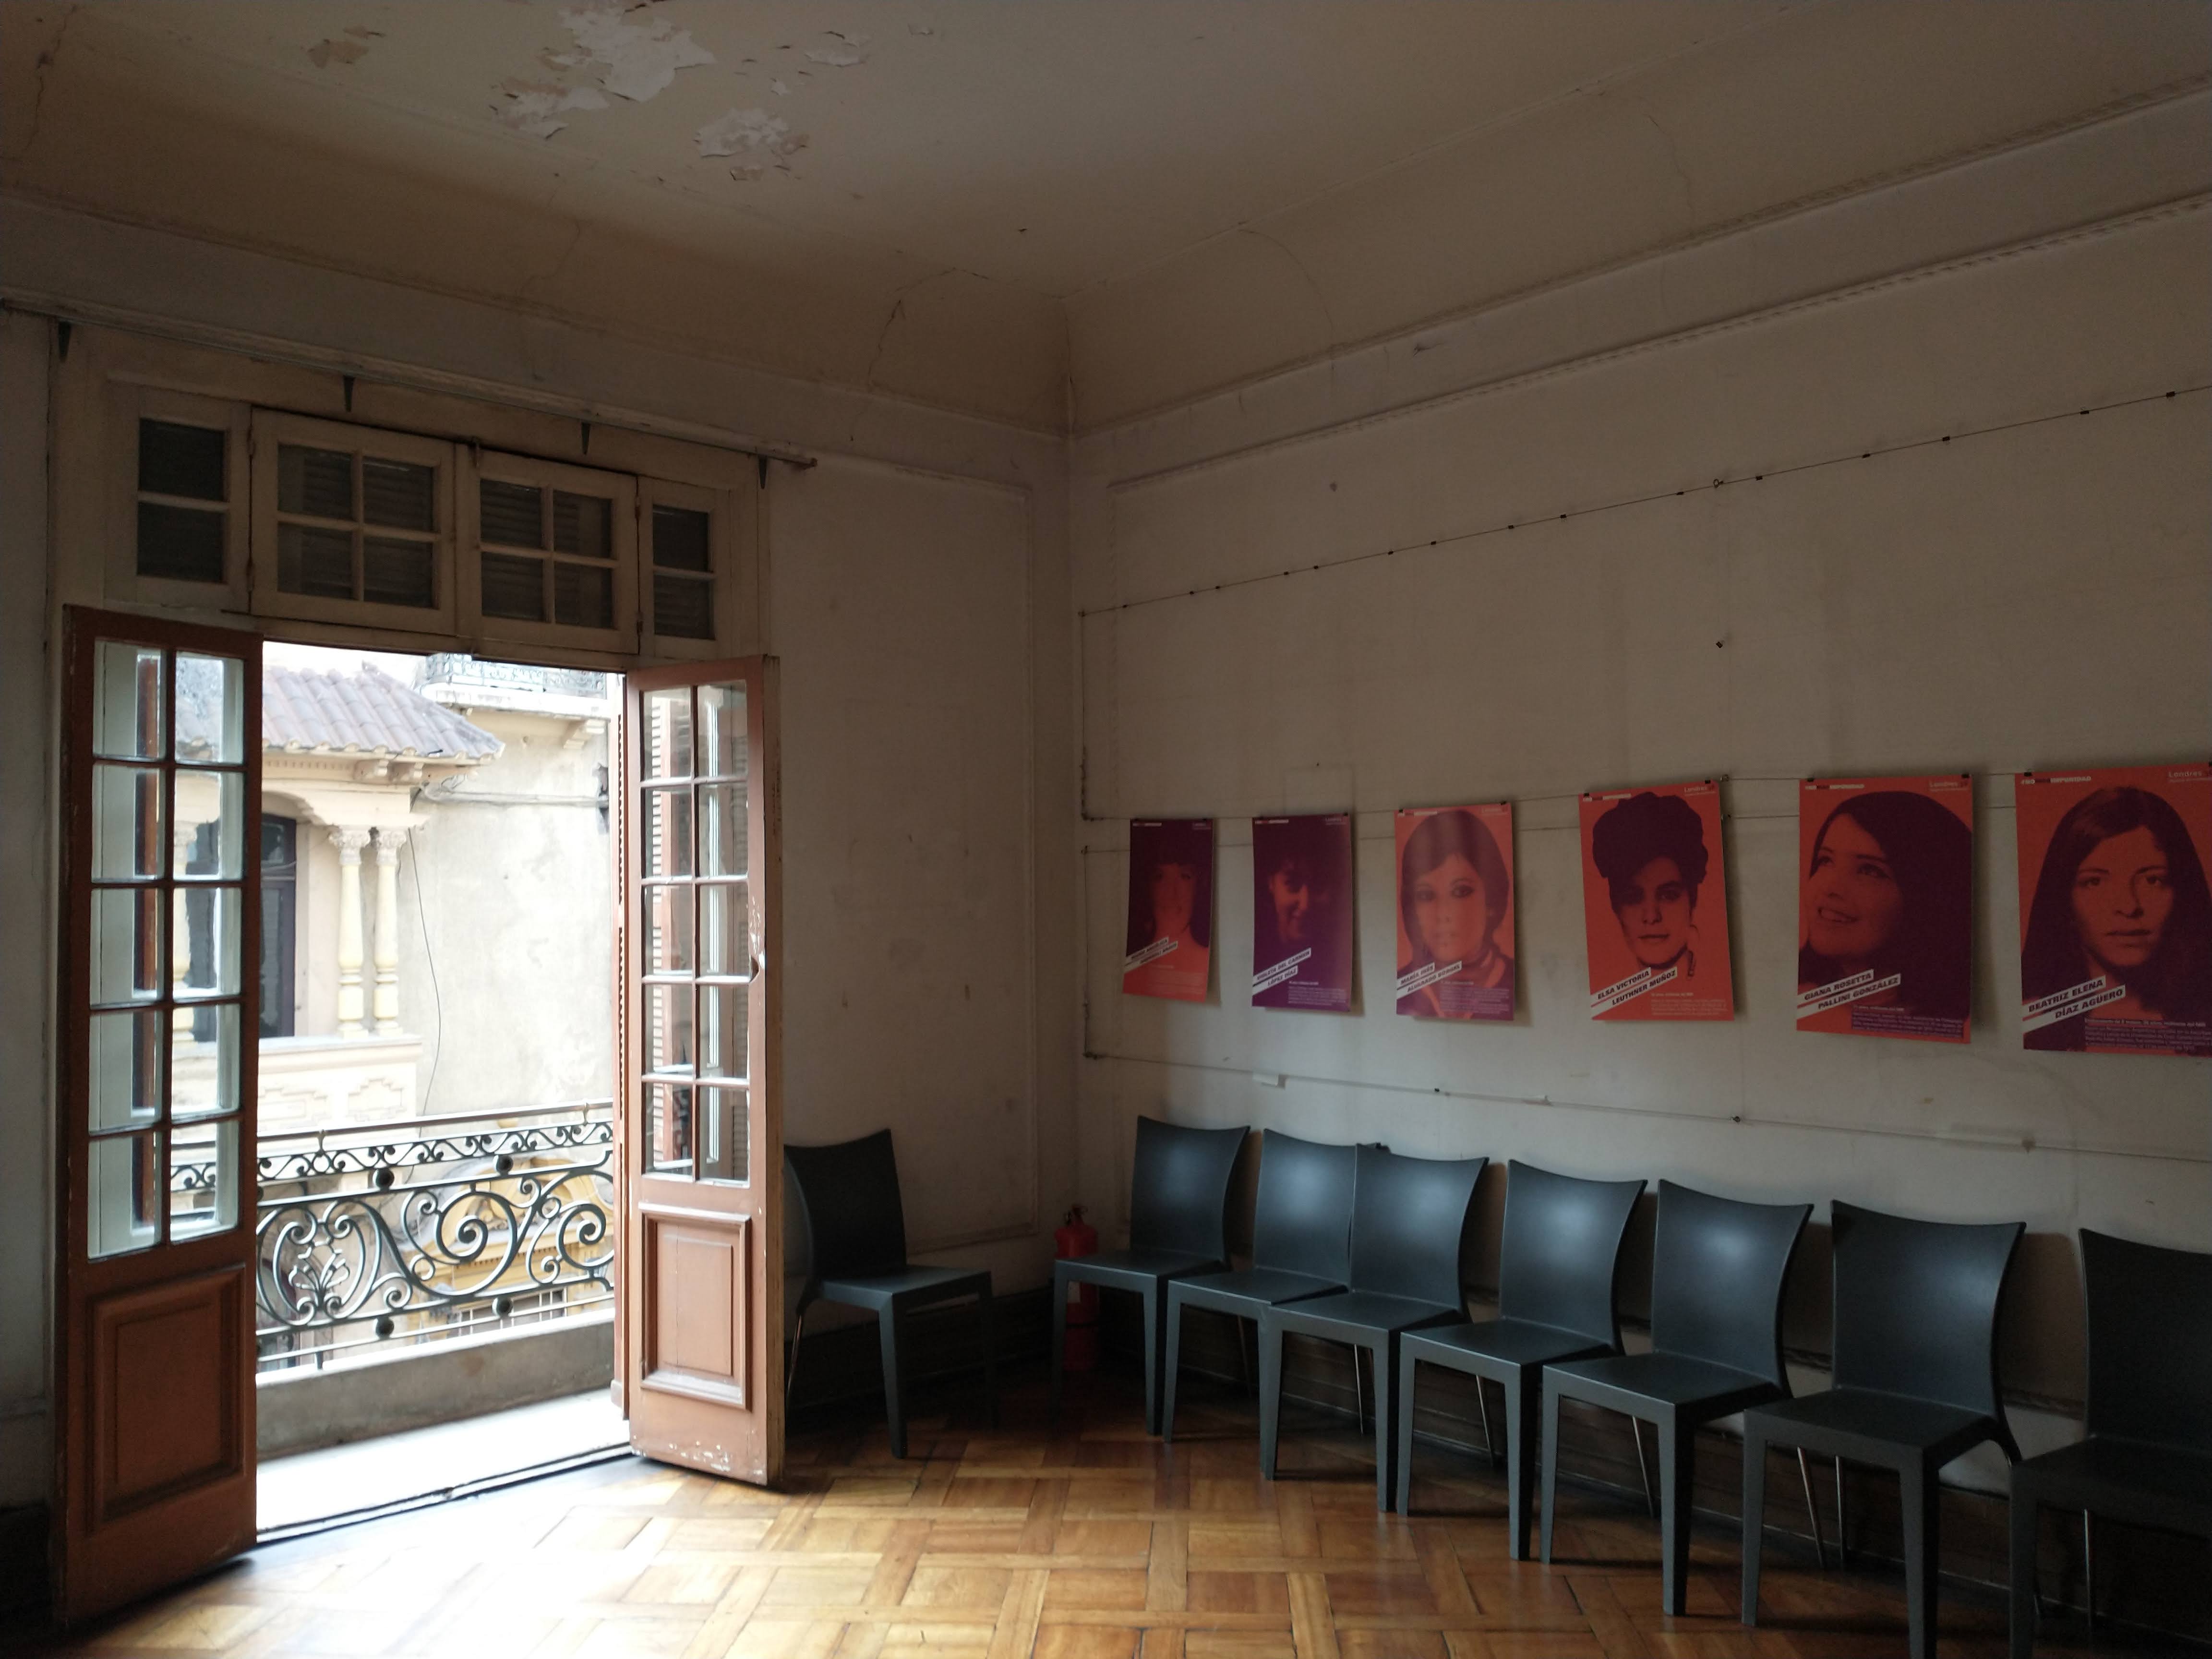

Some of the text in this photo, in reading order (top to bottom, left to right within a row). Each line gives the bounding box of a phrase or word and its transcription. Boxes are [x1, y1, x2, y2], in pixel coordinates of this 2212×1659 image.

[1598, 971, 1649, 1000] ELSA VICTORIA
[1612, 970, 1676, 1006] LEUTHNER MUÑOZ
[1834, 973, 1872, 990] ROSETTA
[2029, 979, 2104, 1012] BEATRIZ ELENA
[1818, 994, 1851, 1010] PALLINI
[2055, 988, 2123, 1019] DÍAZ AGÜERO
